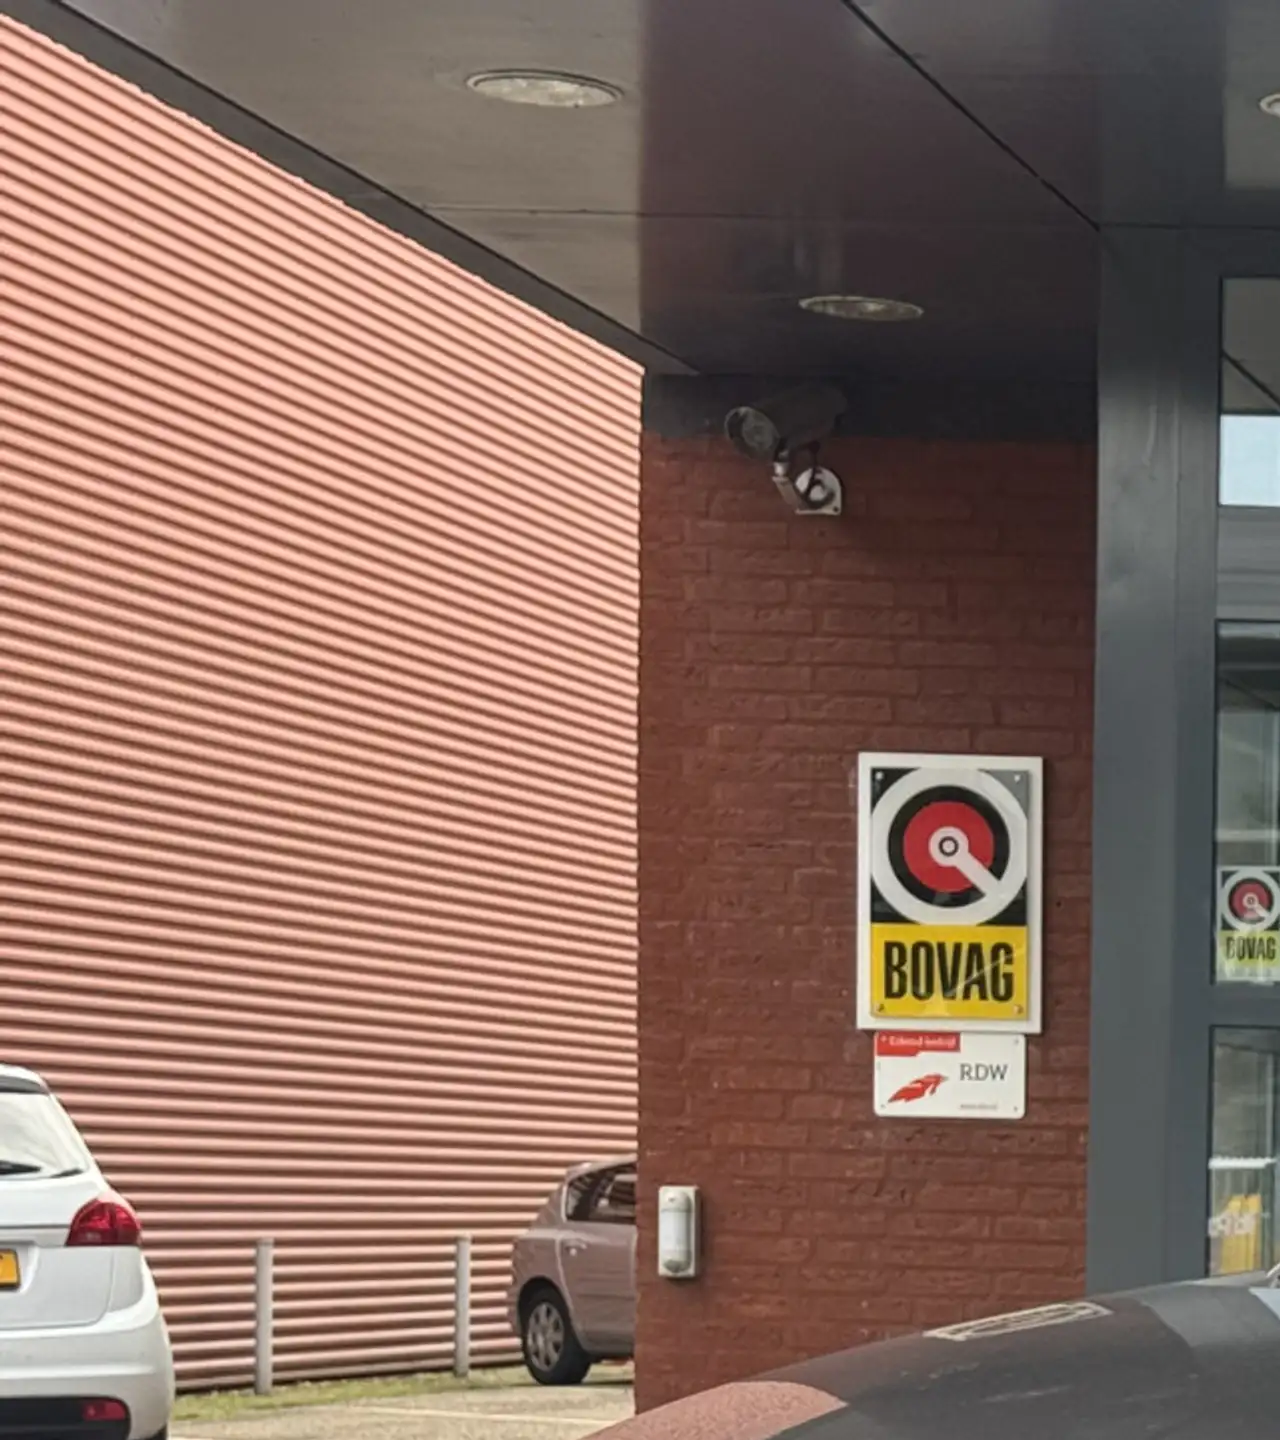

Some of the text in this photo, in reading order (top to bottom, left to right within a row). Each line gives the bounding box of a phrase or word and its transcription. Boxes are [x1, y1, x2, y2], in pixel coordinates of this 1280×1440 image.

[1226, 936, 1276, 961] BOVAG
[884, 941, 1014, 1002] BOVAG
[959, 1063, 1008, 1081] RDW
